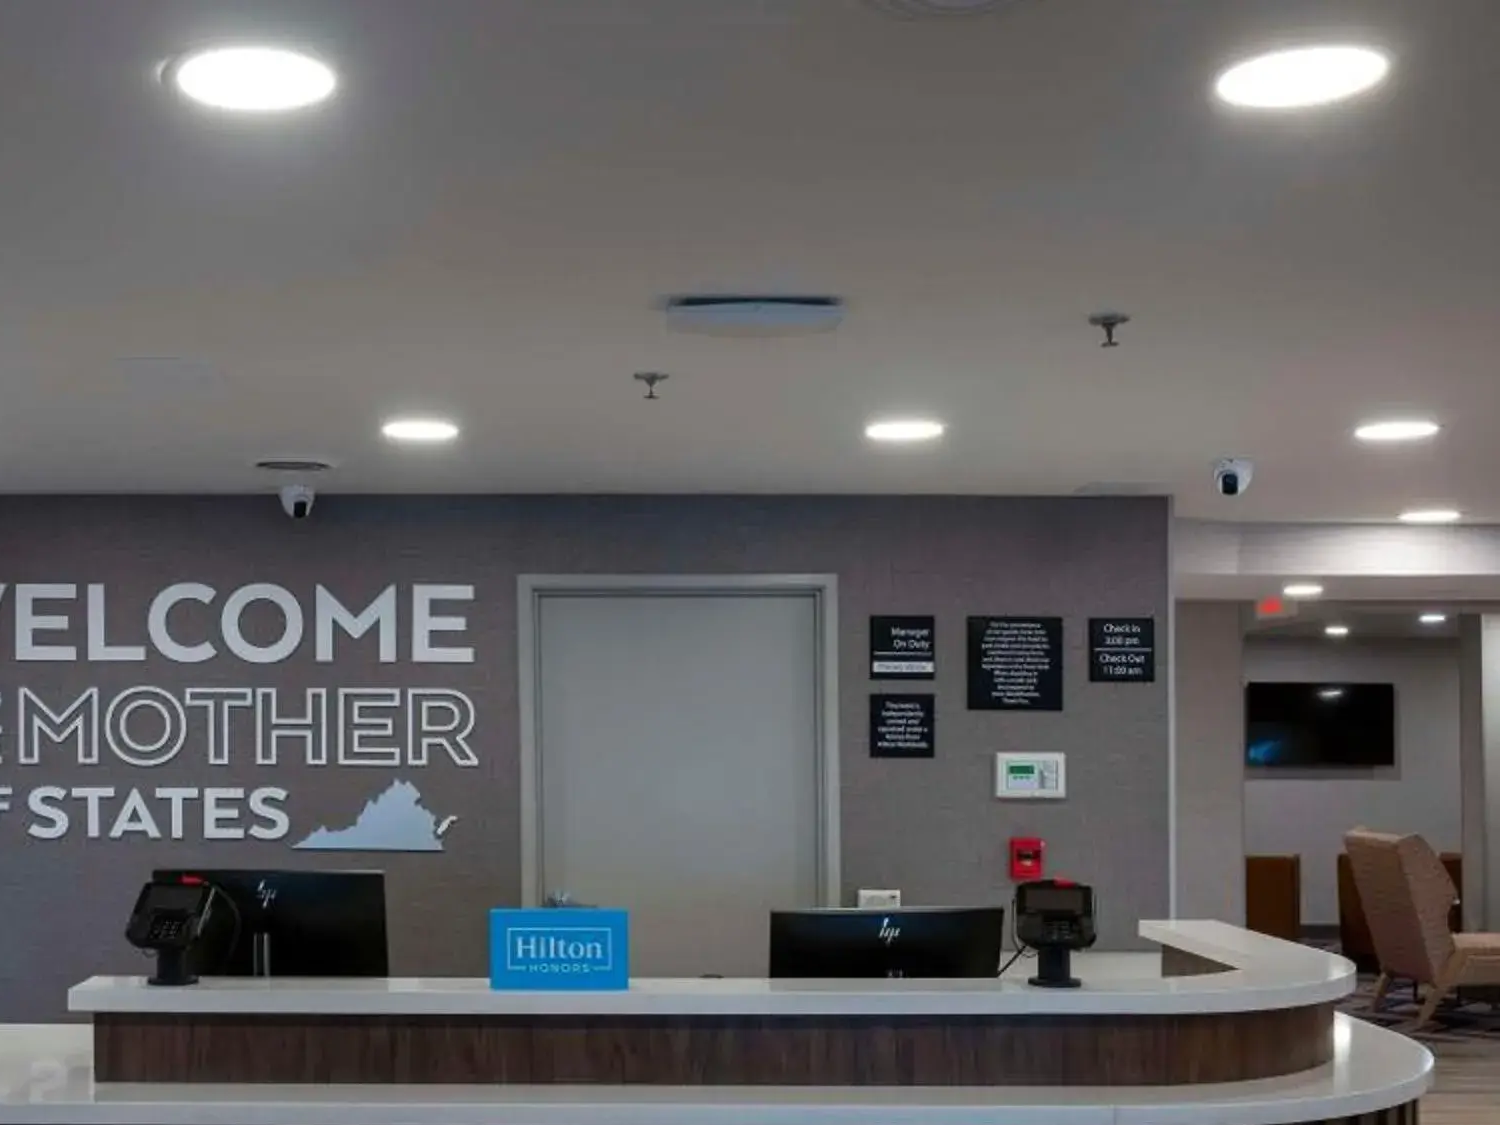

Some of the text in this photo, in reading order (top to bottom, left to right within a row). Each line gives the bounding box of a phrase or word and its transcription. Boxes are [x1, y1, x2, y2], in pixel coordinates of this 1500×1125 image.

[1100, 653, 1127, 663] Check
[19, 686, 479, 766] MOTHER
[27, 786, 290, 840] STATES
[517, 936, 603, 959] Hilton
[528, 963, 591, 973] HONORS
